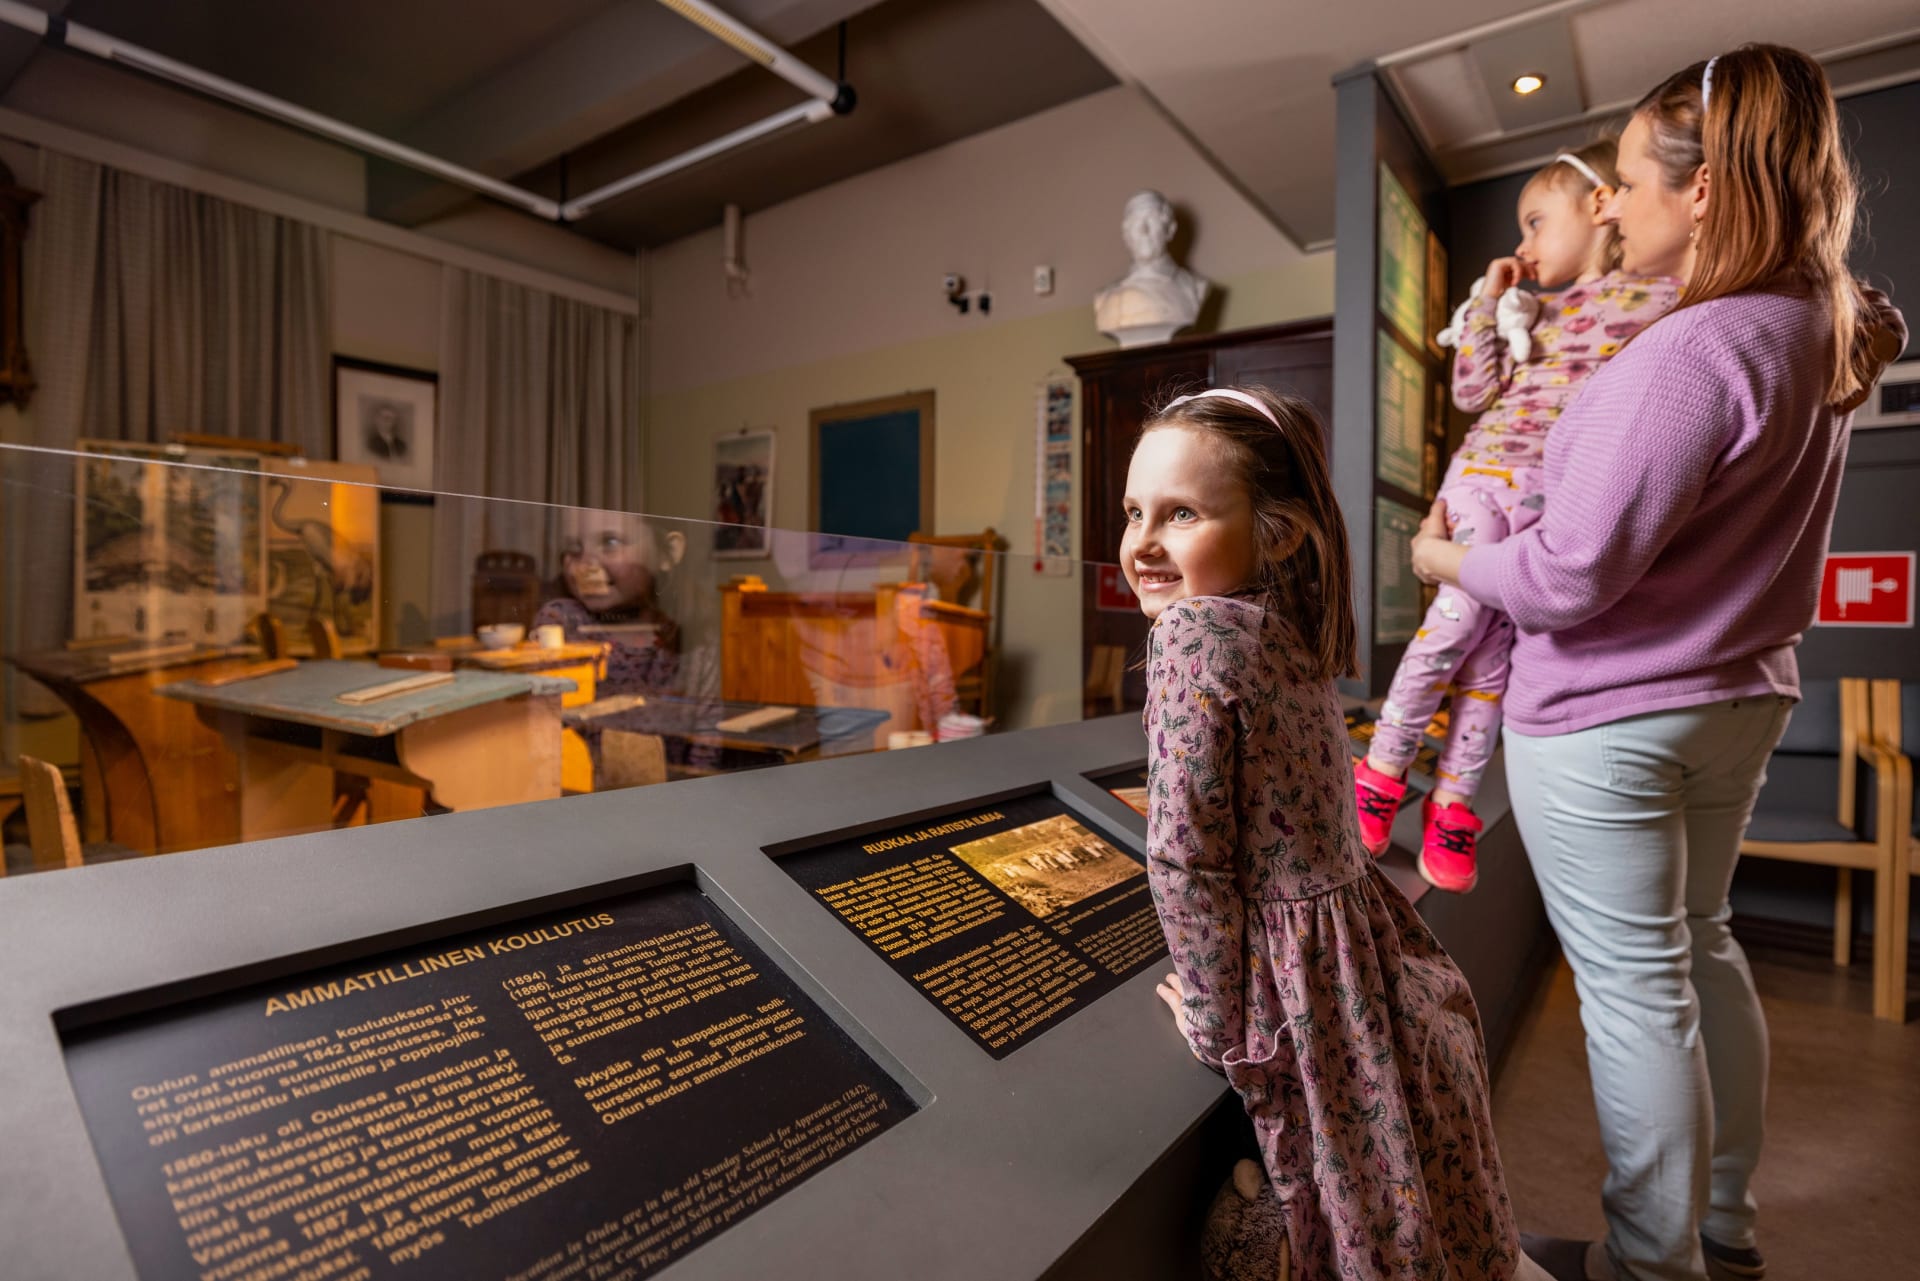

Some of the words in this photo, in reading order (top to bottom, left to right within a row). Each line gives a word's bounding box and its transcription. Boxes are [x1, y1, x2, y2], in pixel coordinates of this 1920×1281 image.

[862, 835, 917, 854] RUOKAA
[915, 831, 933, 841] JA
[928, 819, 976, 836] RAITISTA
[971, 811, 1005, 825] ILMAA
[265, 946, 484, 1016] AMMATILLINEN
[488, 913, 614, 954] KOULUTUS
[501, 970, 546, 990] (1894)
[556, 964, 572, 974] ja
[583, 922, 711, 965] sairaanhoitajatarkurssi
[509, 981, 553, 1000] (1896).
[556, 963, 608, 984] Viimeksi
[612, 950, 657, 967] mainittu
[658, 938, 692, 952] kurssi
[693, 929, 719, 942] kesti
[516, 996, 546, 1009] vain
[547, 982, 584, 1000] kuusi
[585, 965, 645, 987] kuukautta.
[645, 951, 689, 967] Tuolloin
[691, 939, 726, 954] opiske-
[523, 1006, 554, 1021] lijan
[557, 986, 614, 1010] työpäivät
[616, 974, 649, 990] olivat
[650, 963, 684, 980] pitkiä,
[685, 953, 711, 968] puoli
[713, 946, 735, 958] seit-
[533, 1006, 588, 1031] semästä
[591, 991, 637, 1011] aamulla
[640, 979, 669, 996] puoli
[669, 959, 731, 984] kahdeksaan
[730, 954, 743, 963] il-
[539, 1027, 573, 1042] lalla.
[575, 1007, 624, 1029] Päivällä
[627, 1000, 643, 1012] oli
[643, 987, 685, 1005] kahden
[686, 974, 721, 990] tunnin
[721, 963, 752, 977] vapaa
[131, 1074, 198, 1100] Oulun
[209, 1036, 328, 1077] ammatillisen
[336, 1004, 435, 1038] koulutuksen
[440, 994, 471, 1010] juu-
[174, 1081, 220, 1104] ovat
[225, 1059, 298, 1087] vuonna
[303, 1043, 344, 1063] 1842
[349, 1012, 452, 1051] perustetussa
[454, 1004, 478, 1016] kä-
[547, 1043, 564, 1056] ja
[566, 1015, 642, 1047] sunnuntaina
[644, 1006, 660, 1018] oli
[661, 996, 690, 1013] puoli
[691, 983, 726, 1002] päivää
[726, 972, 759, 987] vapaa-
[555, 1054, 576, 1065] ta.
[574, 1060, 632, 1088] Nykyään
[641, 1047, 666, 1061] niin
[672, 1013, 752, 1048] kauppakoulun,
[756, 998, 785, 1013] teolli-
[584, 1064, 660, 1100] suuskoulun
[665, 1049, 694, 1065] kuin
[708, 1008, 794, 1047] sairaanhoitajatar-
[143, 1084, 265, 1130] sityöläisten
[279, 1030, 444, 1086] sunnuntaikoulussa,
[453, 1014, 486, 1033] joka
[148, 1127, 177, 1147] oli
[182, 1093, 288, 1134] tarkoitettu
[292, 1064, 376, 1097] kisälleille
[379, 1058, 396, 1072] ja
[400, 1030, 484, 1062] oppipojille.
[161, 1133, 267, 1177] 1860-luku
[277, 1119, 303, 1136] oli
[311, 1091, 387, 1124] Oulussa
[395, 1056, 489, 1094] merenkulun
[493, 1048, 511, 1062] ja
[592, 1078, 662, 1113] kurssinkin
[668, 1051, 722, 1079] seuraajat
[726, 1030, 769, 1055] jatkavat
[774, 1016, 804, 1033] osana
[601, 1101, 644, 1125] Oulun
[645, 1080, 692, 1105] seudun
[693, 1030, 806, 1084] ammattikorkeakoulua.
[166, 1157, 249, 1195] kaupan
[256, 1101, 406, 1161] kukoistuskautta
[410, 1092, 429, 1108] ja
[432, 1075, 473, 1096] tämä
[477, 1058, 518, 1080] näkyi
[172, 1135, 362, 1212] koulutuksessakin.
[367, 1099, 454, 1137] Merikoulu
[457, 1072, 526, 1105] perustet-
[224, 1173, 305, 1211] vuonna
[310, 1151, 356, 1176] 1863
[359, 1144, 378, 1161] ja
[381, 1102, 490, 1149] kauppakoulu
[491, 1085, 535, 1106] käyn-
[247, 1167, 369, 1222] toimintansa
[376, 1123, 476, 1170] seuraavana
[481, 1097, 544, 1126] vuonna.
[192, 1225, 271, 1265] Vanha
[294, 1151, 451, 1223] sunnuntaikoulu
[468, 1108, 553, 1150] muutettiin
[199, 1239, 289, 1281] vuonna
[301, 1209, 348, 1239] 1887
[361, 1139, 517, 1214] kaksiluokkaiseksi
[522, 1121, 561, 1143] käsi-
[371, 1197, 474, 1249] 1800-luvun
[481, 1166, 540, 1198] lopulla
[547, 1148, 580, 1168] saa-
[382, 1209, 404, 1229] ja
[410, 1167, 497, 1212] sittemmin
[503, 1134, 571, 1171] ammatti-
[389, 1231, 445, 1264] myös
[460, 1161, 590, 1227] Teollisuuskoulu
